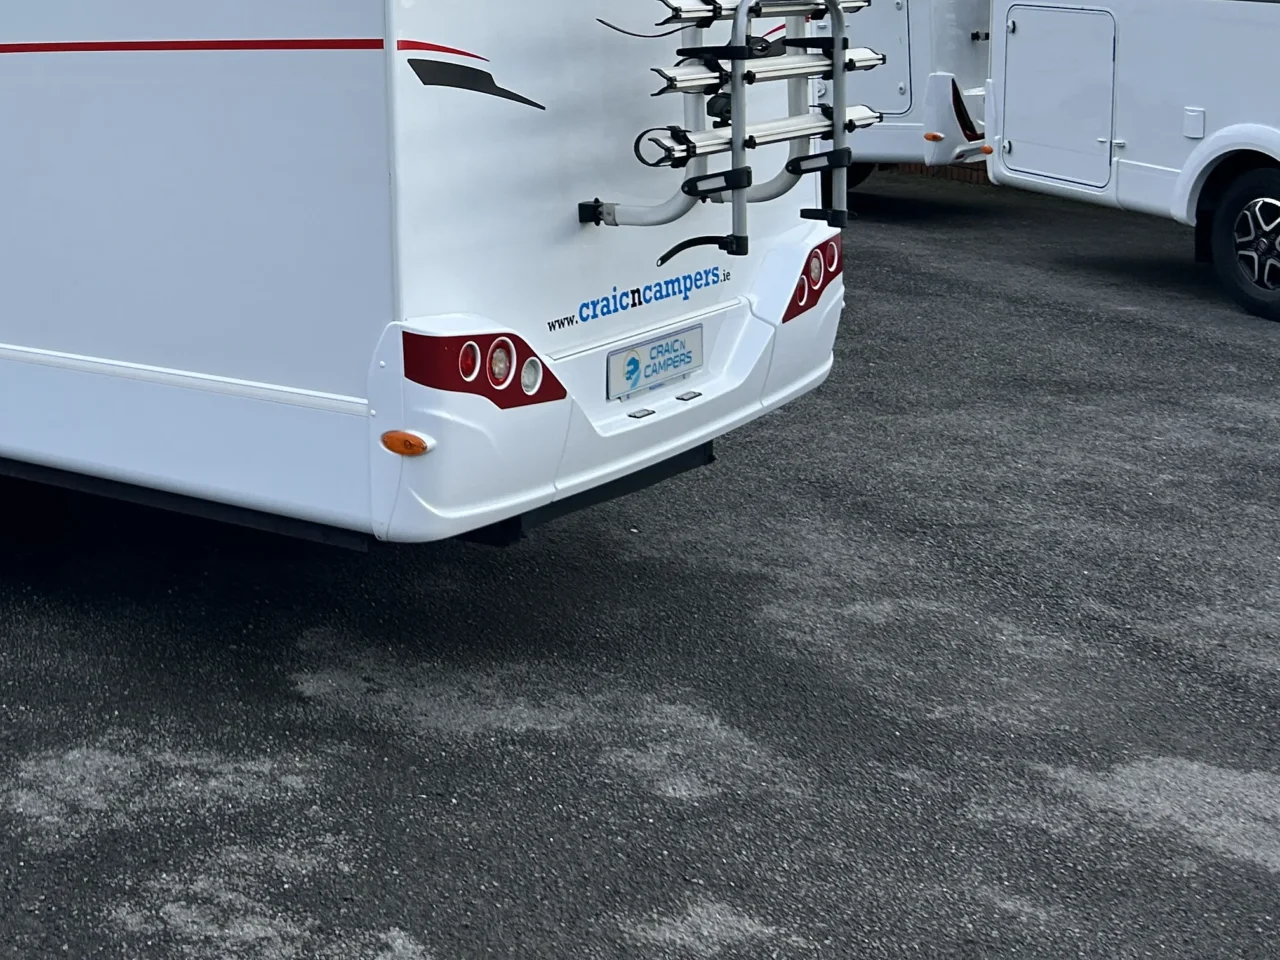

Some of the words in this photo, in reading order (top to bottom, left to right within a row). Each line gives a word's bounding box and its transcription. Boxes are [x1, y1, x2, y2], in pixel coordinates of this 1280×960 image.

[547, 266, 731, 332] www.craicncampers.ie
[649, 339, 680, 360] CRAIC
[643, 350, 693, 378] CAMPERS
